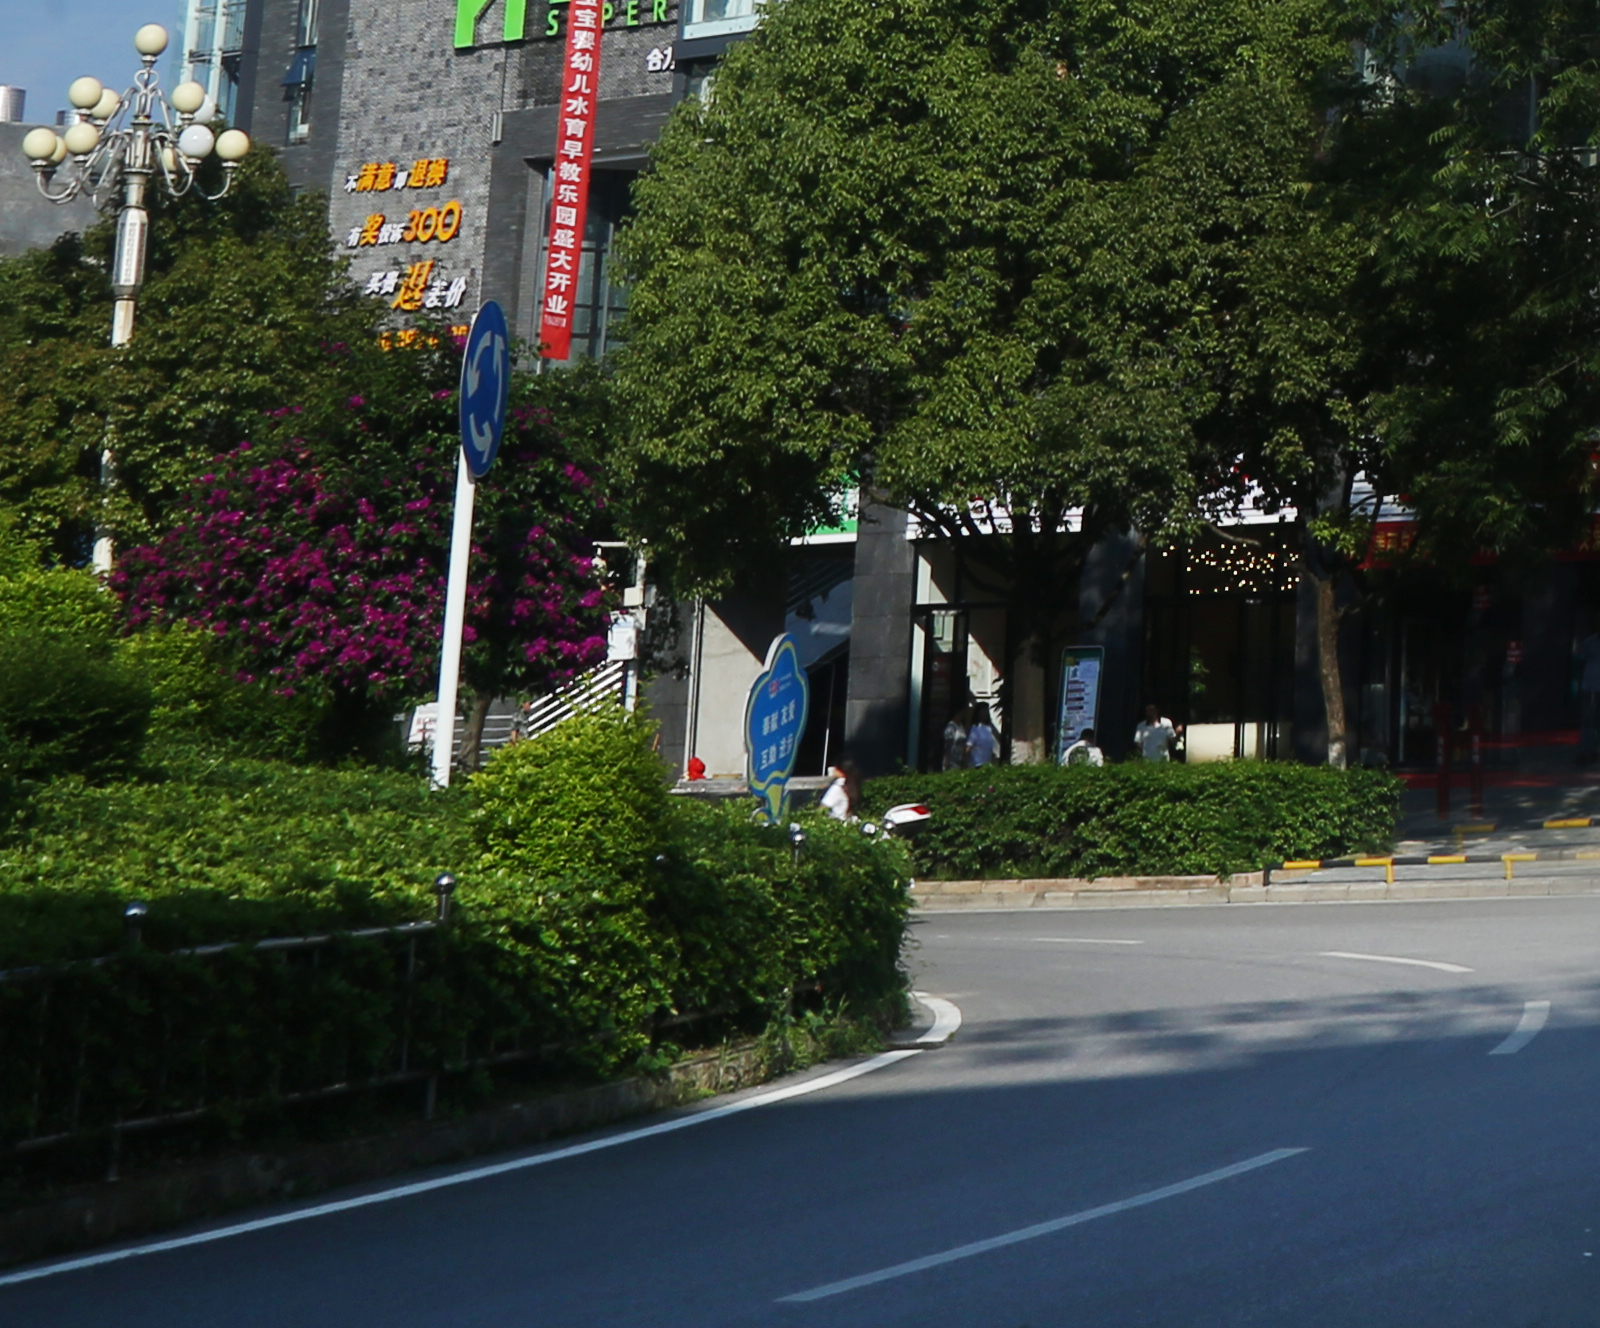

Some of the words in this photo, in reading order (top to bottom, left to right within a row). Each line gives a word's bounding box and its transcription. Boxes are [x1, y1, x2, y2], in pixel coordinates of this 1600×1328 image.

[344, 158, 449, 192] 不满意即退换
